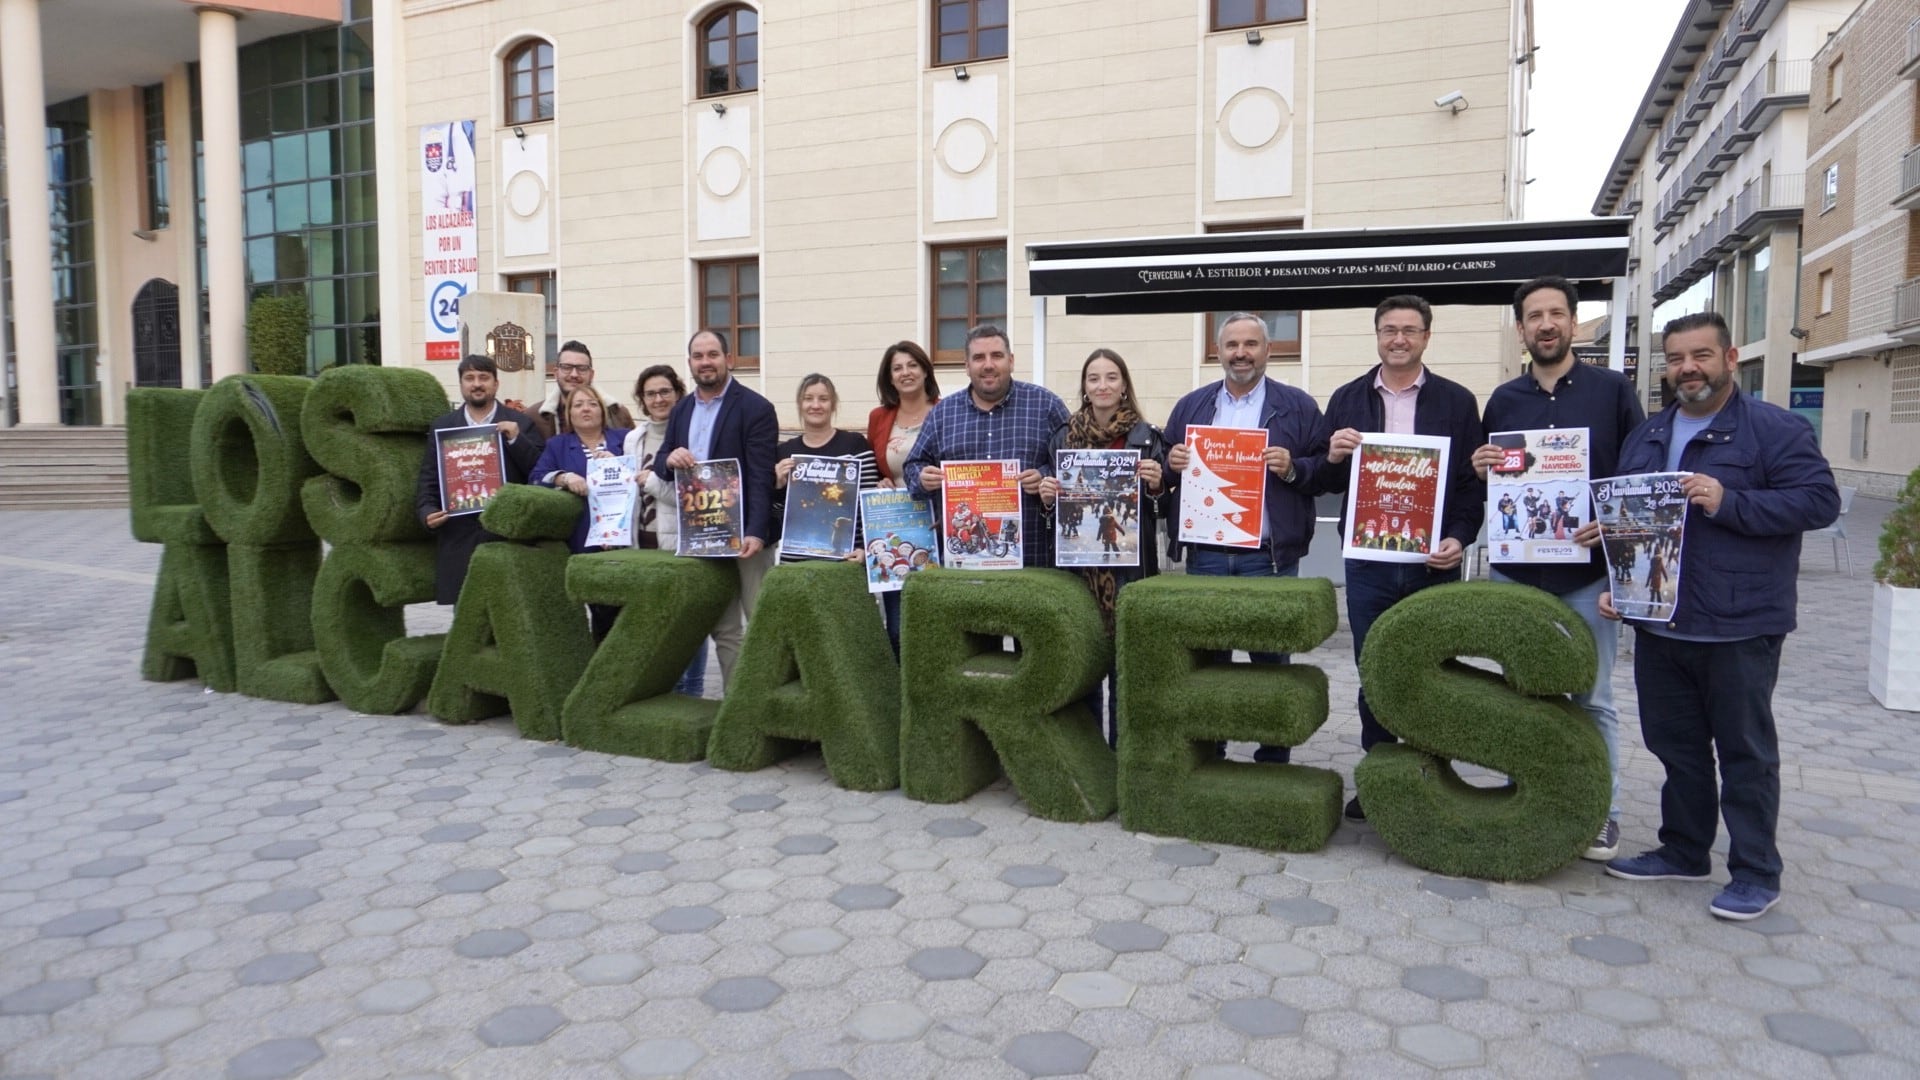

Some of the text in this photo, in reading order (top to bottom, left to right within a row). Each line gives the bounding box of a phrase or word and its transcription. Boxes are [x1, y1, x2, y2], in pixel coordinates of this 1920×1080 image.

[425, 215, 437, 231] LOS
[439, 235, 462, 252] POR UN
[424, 257, 477, 275] CENTRO DE SALUD
[1207, 267, 1262, 278] ESTRIBOR
[1272, 266, 1331, 276] DESAYUNOS
[1337, 264, 1368, 274] TAPAS
[1374, 261, 1405, 273] MENÚ
[1407, 262, 1446, 272] DIARIO
[1452, 260, 1497, 271] CARNES
[439, 298, 460, 317] 24
[1203, 438, 1235, 450] Decora el
[126, 364, 450, 548] LOS
[1060, 454, 1136, 470] Navilandia 2024
[1225, 450, 1234, 460] de
[1236, 451, 1263, 463] Navidad
[1504, 455, 1521, 469] 28
[1004, 463, 1014, 473] 14
[1366, 456, 1434, 478] mercadillo
[1541, 460, 1582, 470] NAVIDEÑO
[1597, 482, 1653, 501] Navilandia
[683, 489, 736, 512] 2025
[141, 483, 1612, 882] ALCÁZARES
